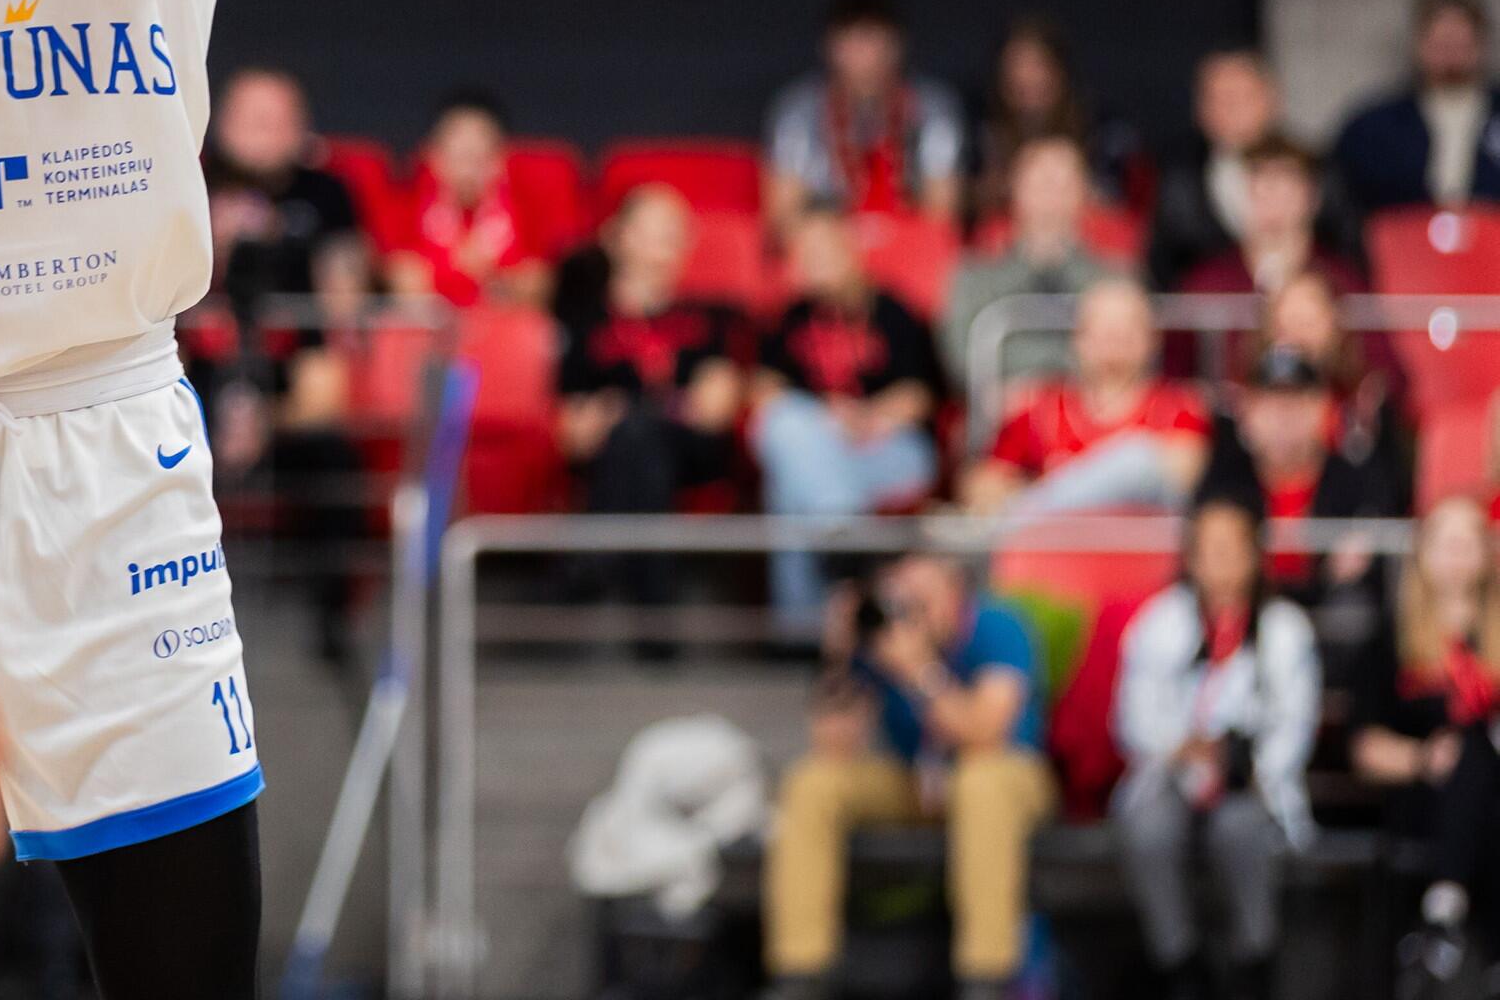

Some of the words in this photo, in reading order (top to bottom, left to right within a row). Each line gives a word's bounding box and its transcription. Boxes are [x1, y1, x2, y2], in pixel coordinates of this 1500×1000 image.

[43, 158, 153, 184] KONTEINERIŲ
[45, 178, 149, 205] TERMINALAS
[52, 272, 108, 291] GROUP
[212, 676, 252, 755] 11
